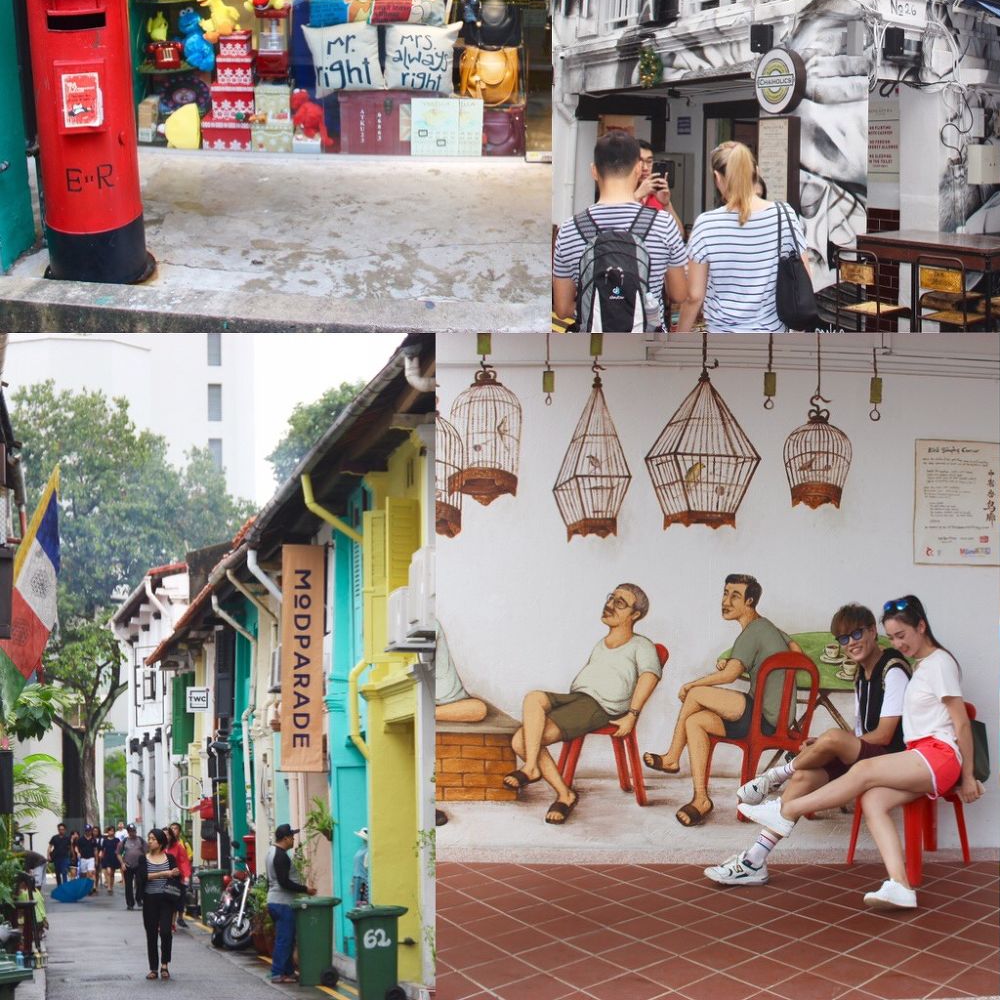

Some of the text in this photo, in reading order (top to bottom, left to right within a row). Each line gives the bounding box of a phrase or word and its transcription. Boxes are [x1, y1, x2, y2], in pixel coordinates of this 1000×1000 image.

[326, 34, 357, 55] mr.
[399, 34, 438, 51] mrs.
[392, 46, 449, 73] always
[316, 56, 373, 90] right
[401, 71, 443, 92] right
[362, 928, 392, 950] 62
